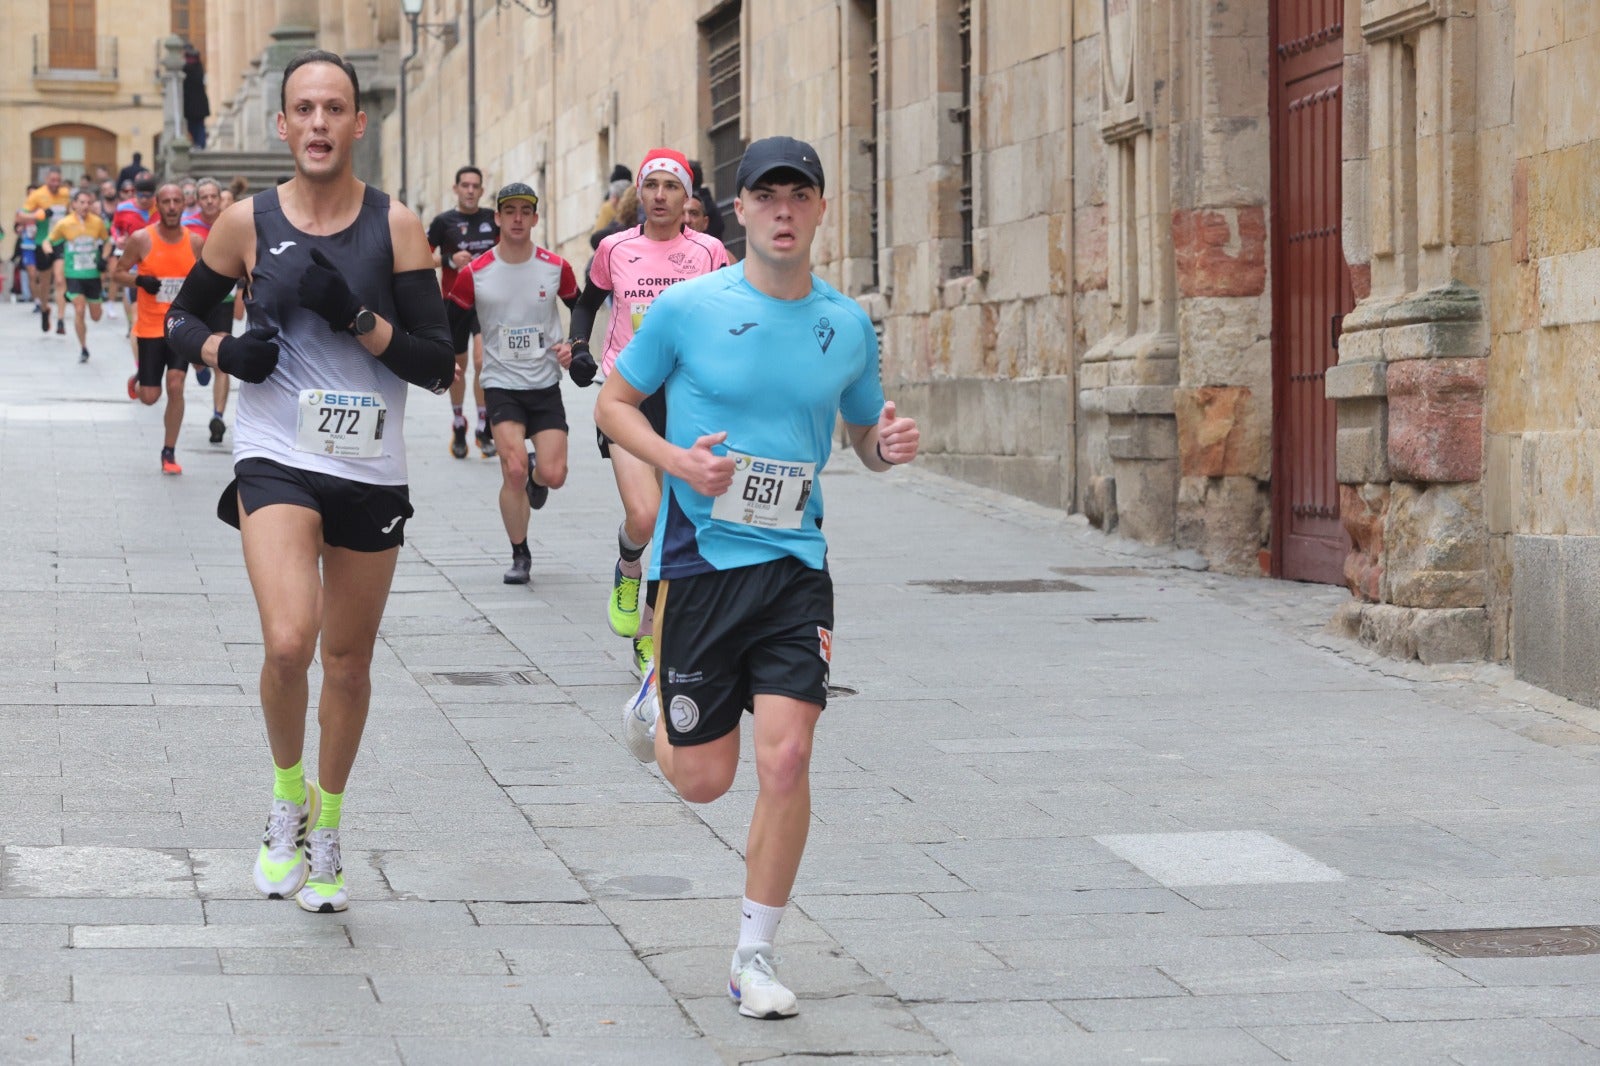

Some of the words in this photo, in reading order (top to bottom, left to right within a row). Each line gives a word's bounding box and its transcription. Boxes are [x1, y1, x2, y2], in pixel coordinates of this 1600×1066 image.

[624, 289, 655, 298] PARA
[508, 335, 530, 349] 626
[324, 393, 381, 407] SETEL
[318, 407, 360, 435] 272
[751, 461, 807, 477] SETEL
[742, 475, 784, 506] 631
